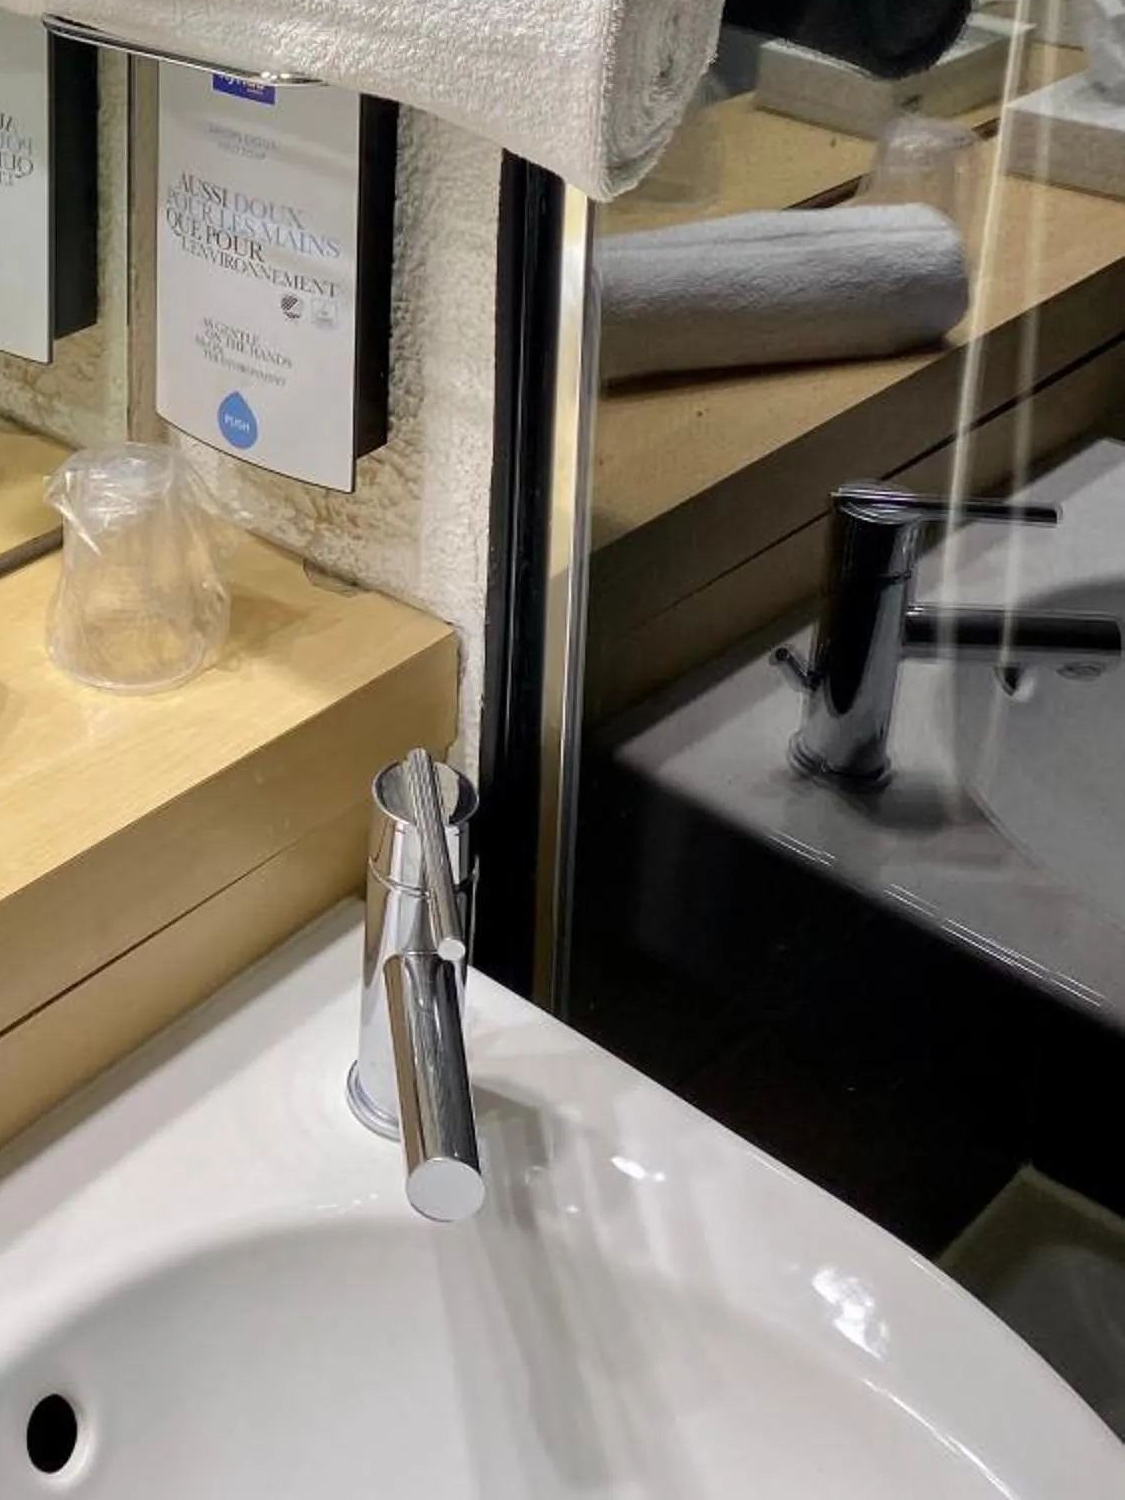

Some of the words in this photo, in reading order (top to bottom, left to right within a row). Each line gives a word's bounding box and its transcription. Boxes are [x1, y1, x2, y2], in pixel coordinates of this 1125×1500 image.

[166, 185, 216, 225] POUR
[220, 207, 256, 237] LES
[260, 221, 340, 259] MAINS
[177, 171, 228, 208] AUSSI
[233, 192, 306, 230] DOUX
[166, 207, 202, 241] QUE
[206, 224, 266, 263] POUR
